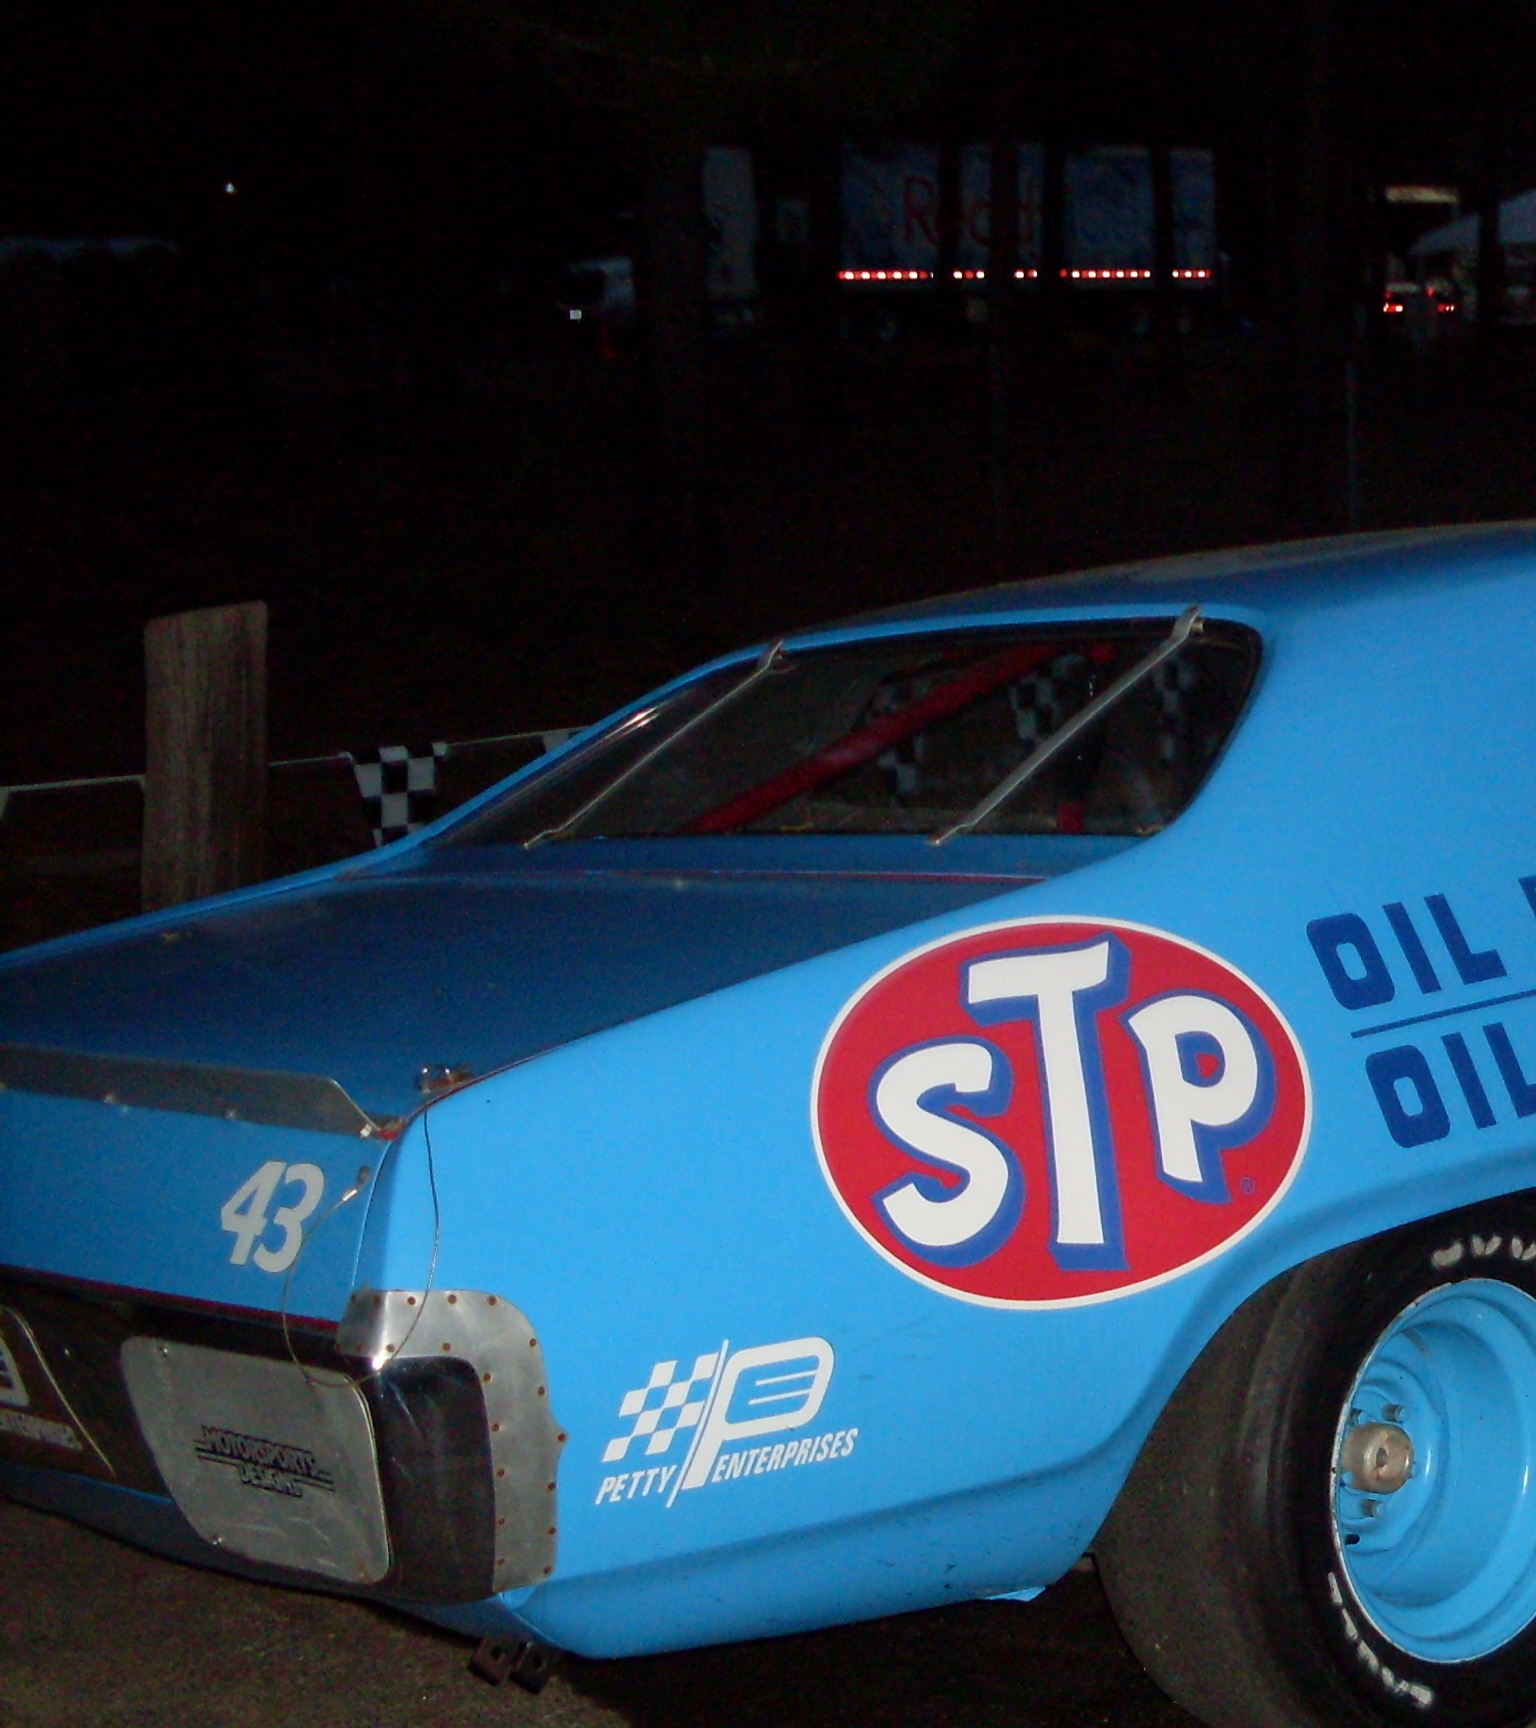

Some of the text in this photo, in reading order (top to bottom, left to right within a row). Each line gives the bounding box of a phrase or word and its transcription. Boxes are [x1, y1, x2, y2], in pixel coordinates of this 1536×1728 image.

[1306, 893, 1507, 1010] OIL
[867, 931, 1277, 1272] STP
[221, 1161, 325, 1273] 43
[595, 1427, 859, 1505] PETTY ENTERPRISES
